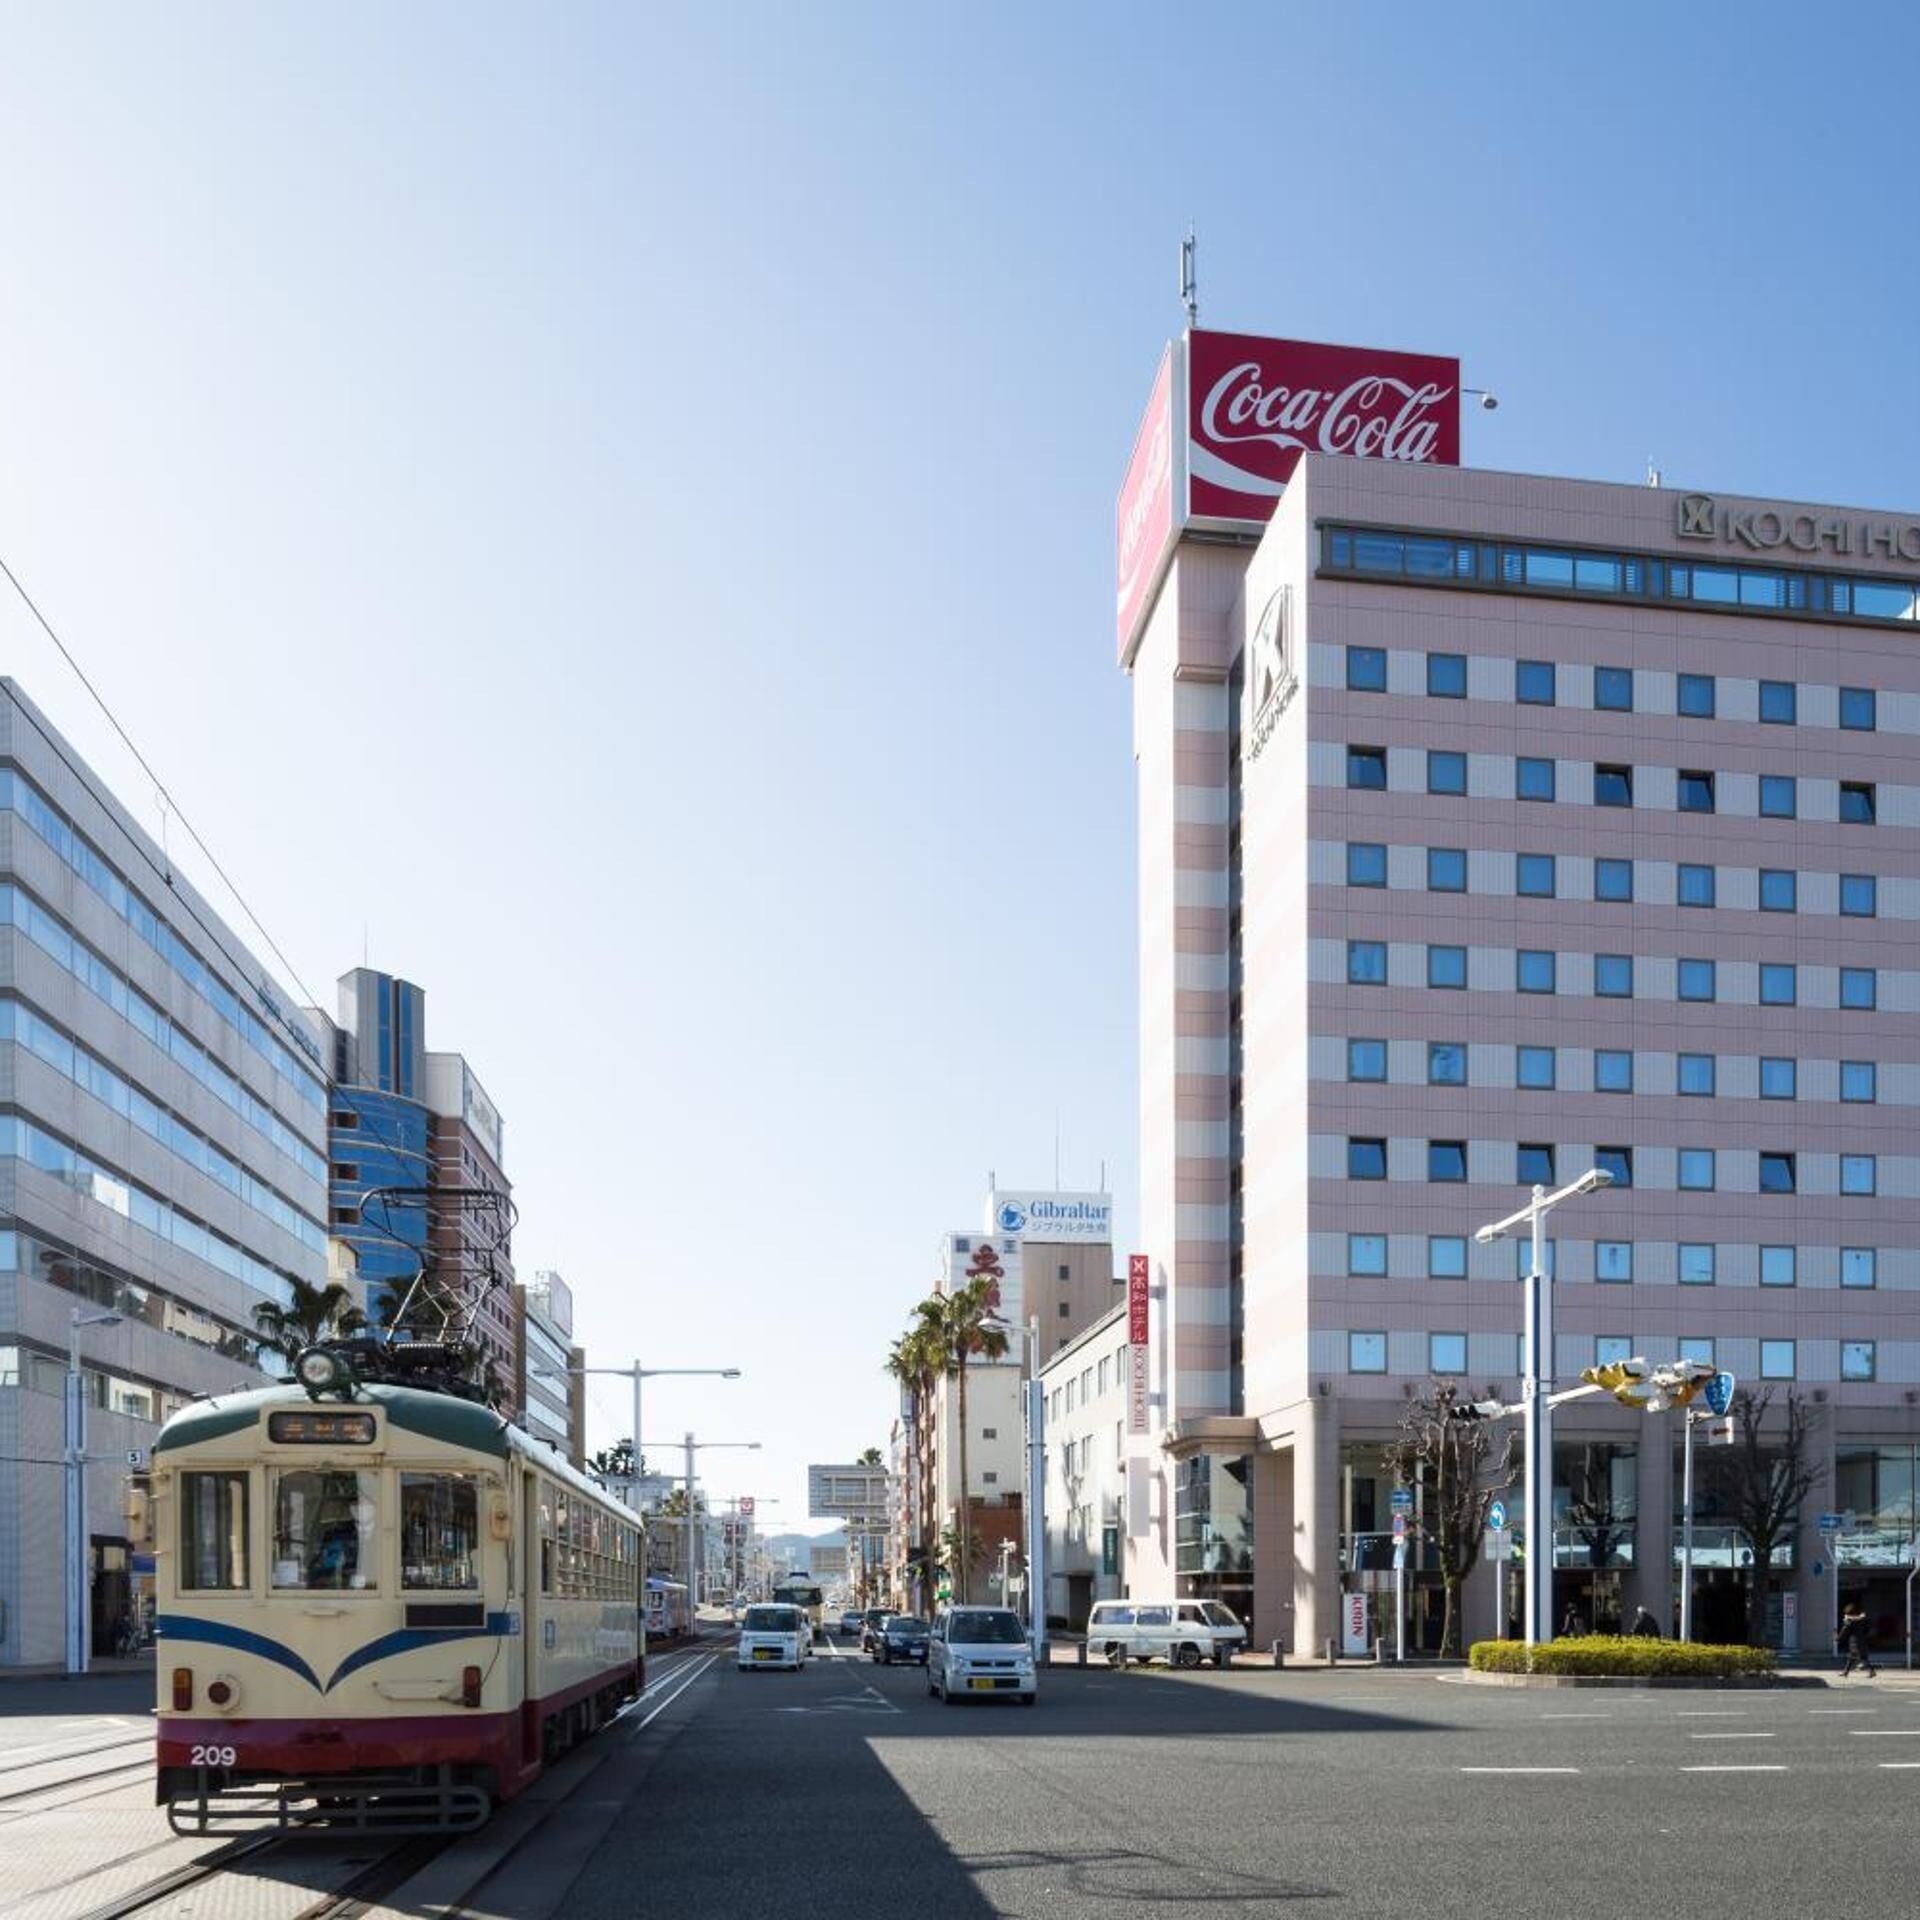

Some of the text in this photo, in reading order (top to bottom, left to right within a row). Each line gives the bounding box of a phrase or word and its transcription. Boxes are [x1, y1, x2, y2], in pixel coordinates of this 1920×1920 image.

[1201, 362, 1454, 462] Coca-Cola
[1725, 508, 1856, 554] KOCHI
[1030, 1200, 1109, 1219] Gibraltar
[1351, 1596, 1364, 1635] KIRIN
[190, 1744, 237, 1767] 209
